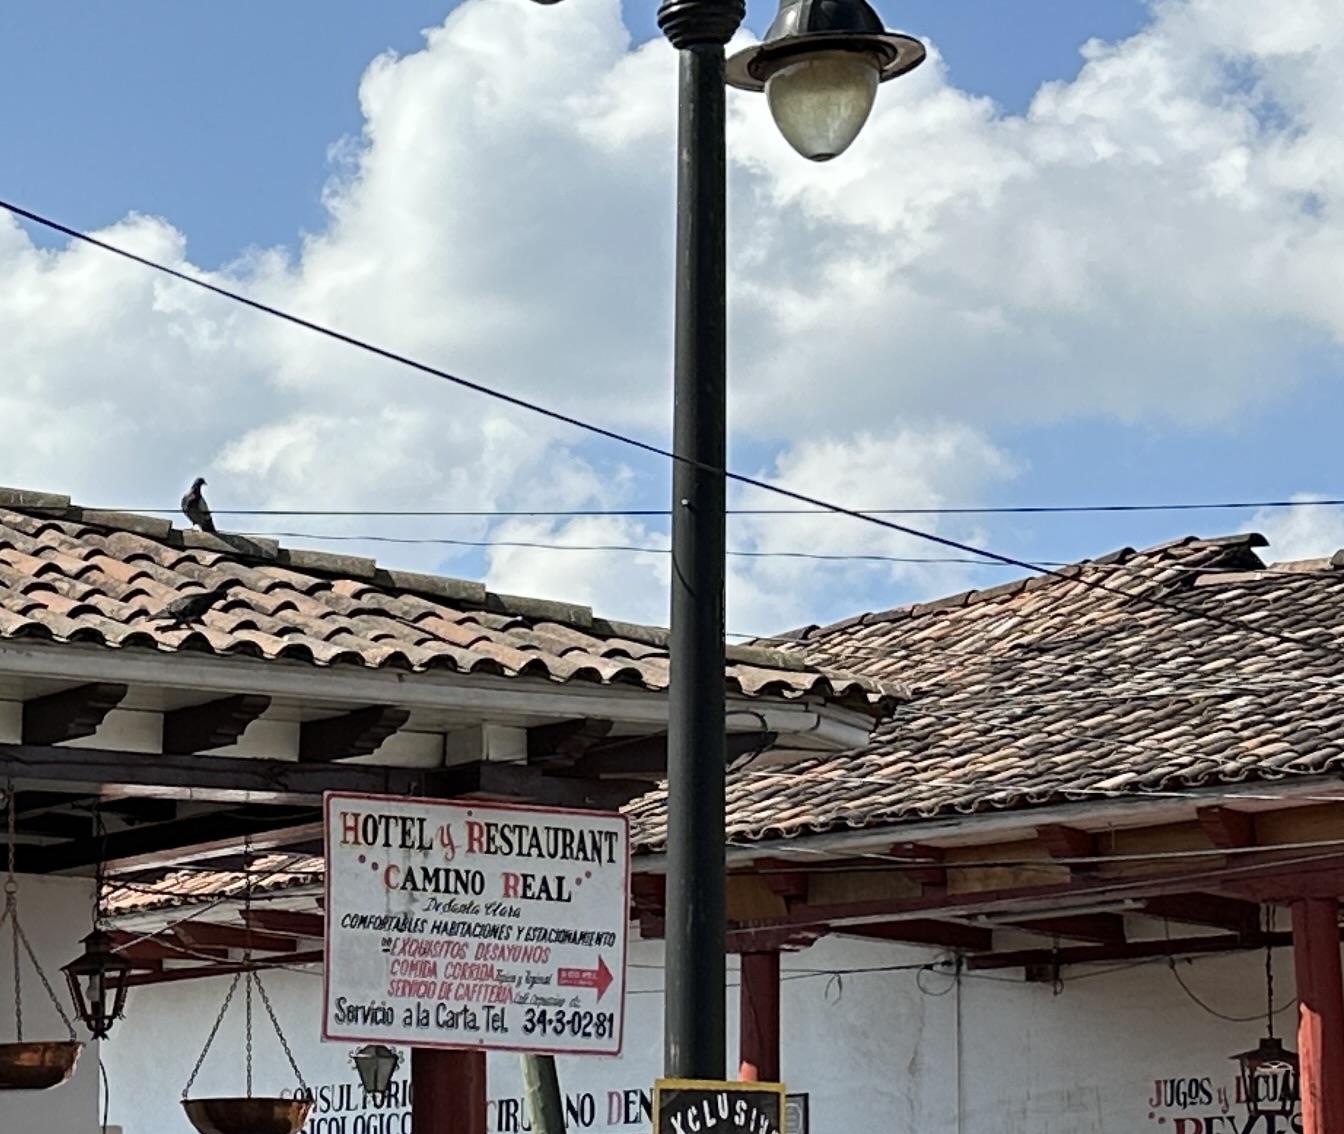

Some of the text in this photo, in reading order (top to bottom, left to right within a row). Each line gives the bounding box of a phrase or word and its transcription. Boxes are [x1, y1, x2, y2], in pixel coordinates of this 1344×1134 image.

[340, 812, 618, 867] HOTEL y RESTAURANT
[383, 863, 572, 902] CAMINO REAL
[430, 920, 513, 941] HABITACIONES
[474, 942, 551, 964] DESAYUNOS
[390, 958, 438, 979] COMIDA
[387, 978, 437, 999] SERVICIO
[335, 996, 394, 1025] Servicio
[403, 1006, 413, 1028] a
[416, 1001, 430, 1029] la
[1149, 1077, 1213, 1110] JUGOS
[1217, 1086, 1230, 1114] y
